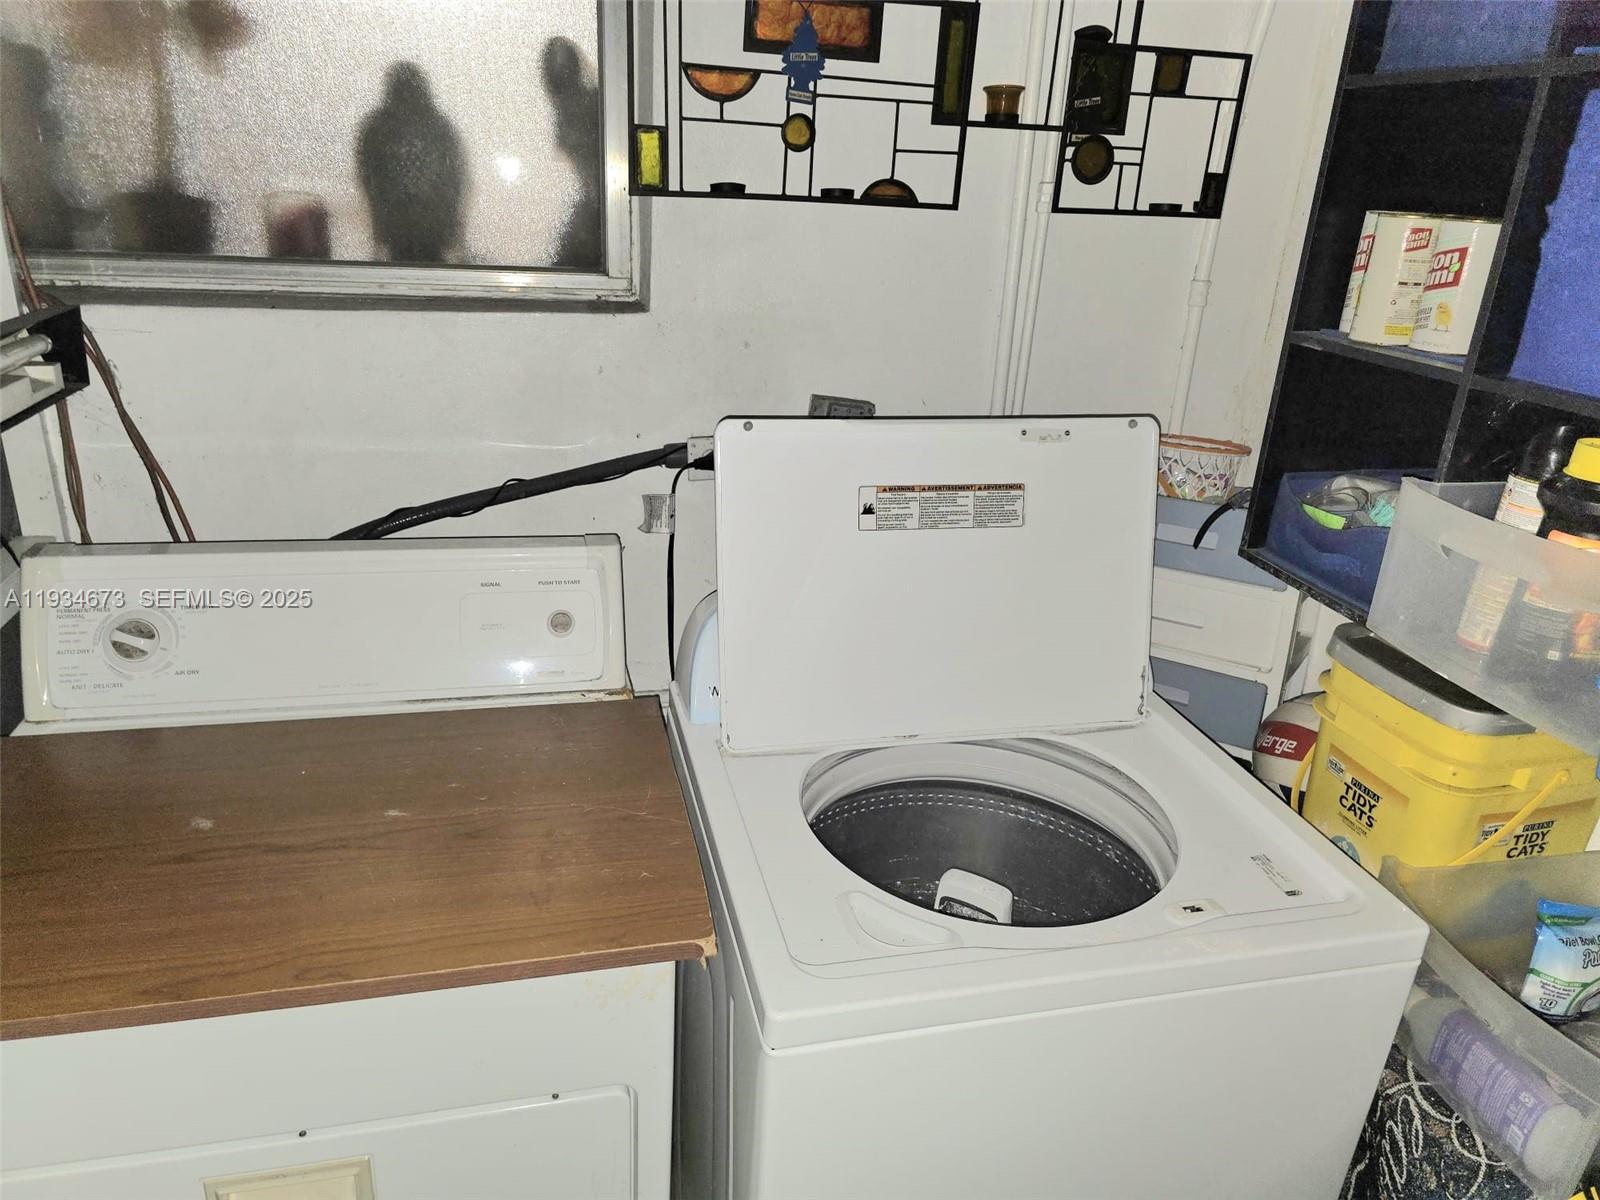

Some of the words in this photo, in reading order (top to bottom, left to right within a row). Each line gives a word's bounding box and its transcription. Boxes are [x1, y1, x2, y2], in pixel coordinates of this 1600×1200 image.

[1432, 251, 1460, 270] on
[1344, 782, 1377, 814] TIDY
[1351, 777, 1380, 803] PURINA
[1339, 794, 1375, 828] CATS
[1513, 829, 1552, 846] TIDY
[1506, 842, 1547, 859] CATS
[1539, 997, 1558, 1009] 10
